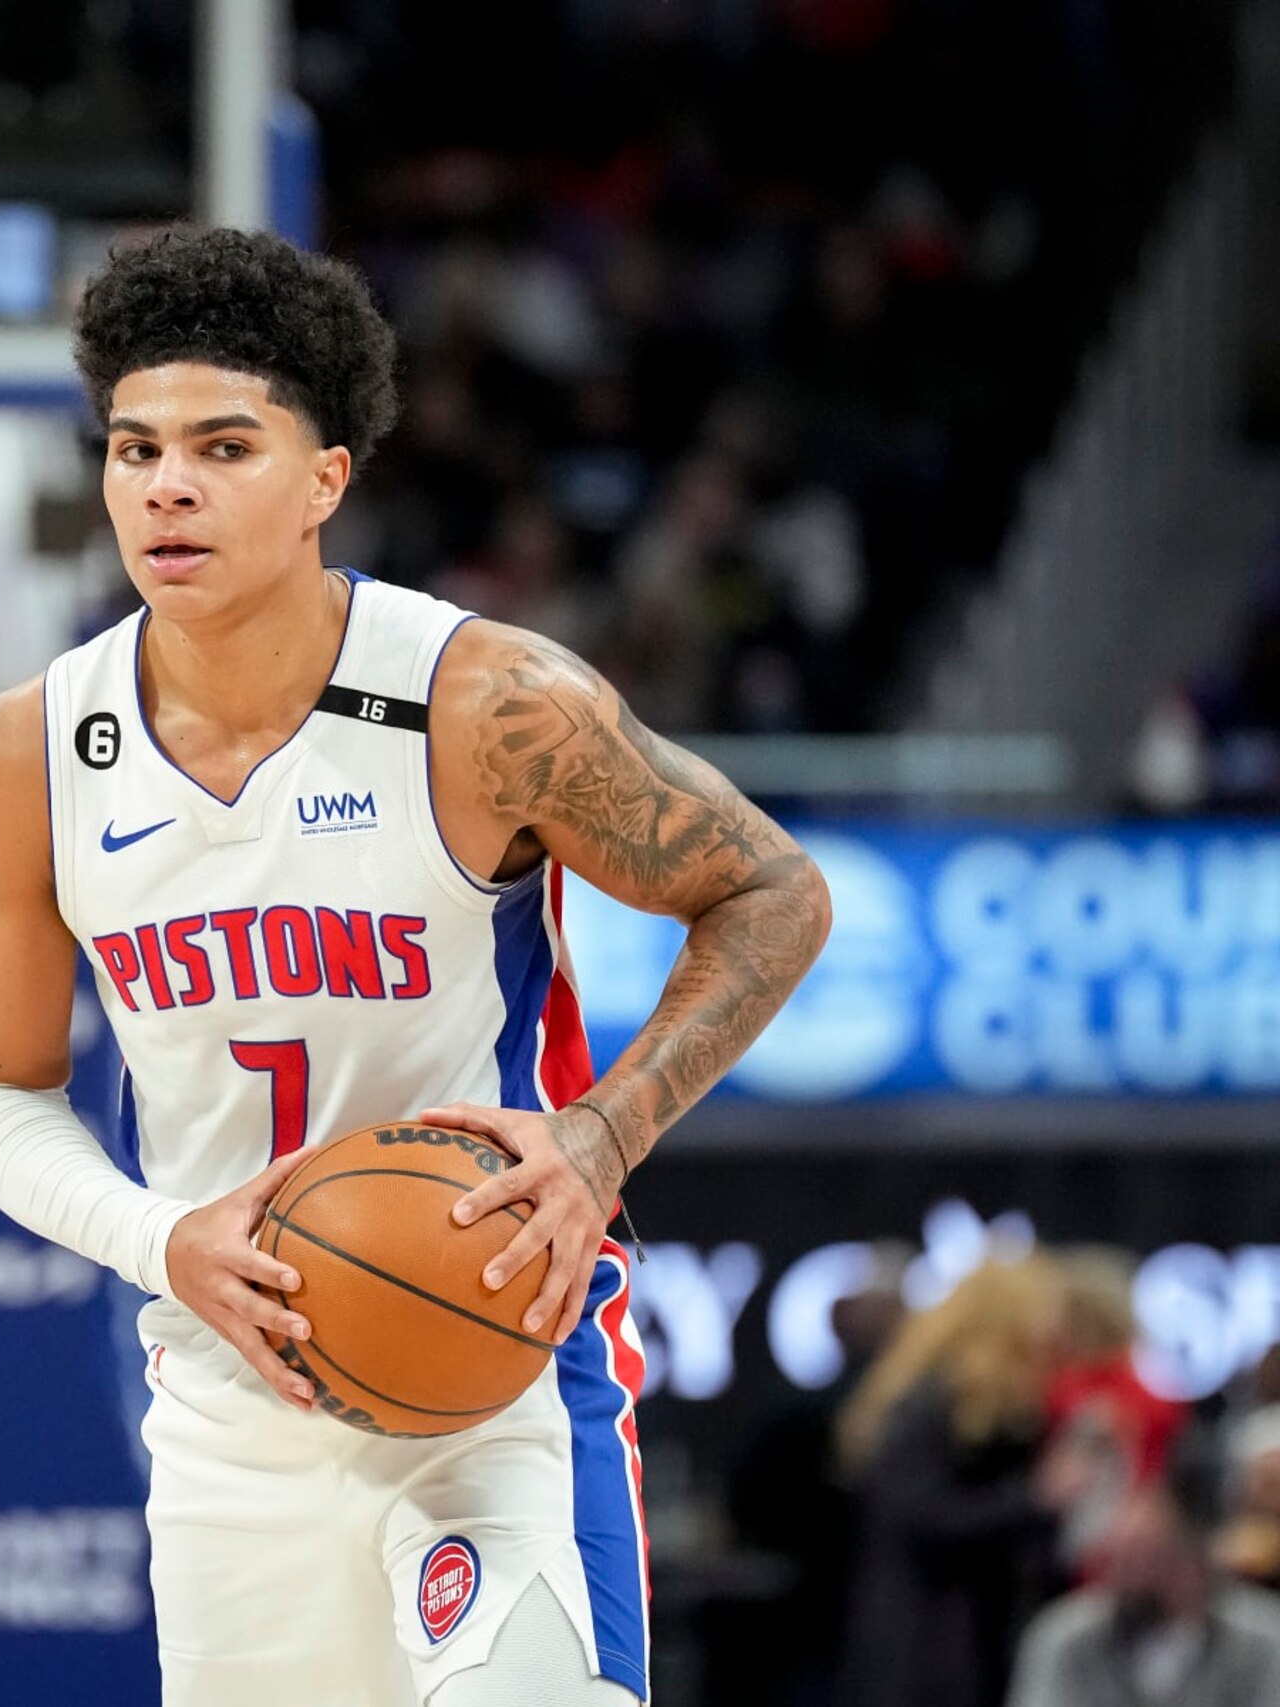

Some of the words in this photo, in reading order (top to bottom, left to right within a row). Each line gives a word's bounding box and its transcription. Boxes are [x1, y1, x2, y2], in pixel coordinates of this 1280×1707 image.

[358, 697, 387, 721] 16
[88, 721, 115, 762] 6
[297, 790, 376, 824] UWM
[92, 904, 432, 1012] PISTONS
[229, 1038, 310, 1168] 7
[427, 1566, 465, 1599] DETROIT
[427, 1582, 465, 1617] PISTONS
